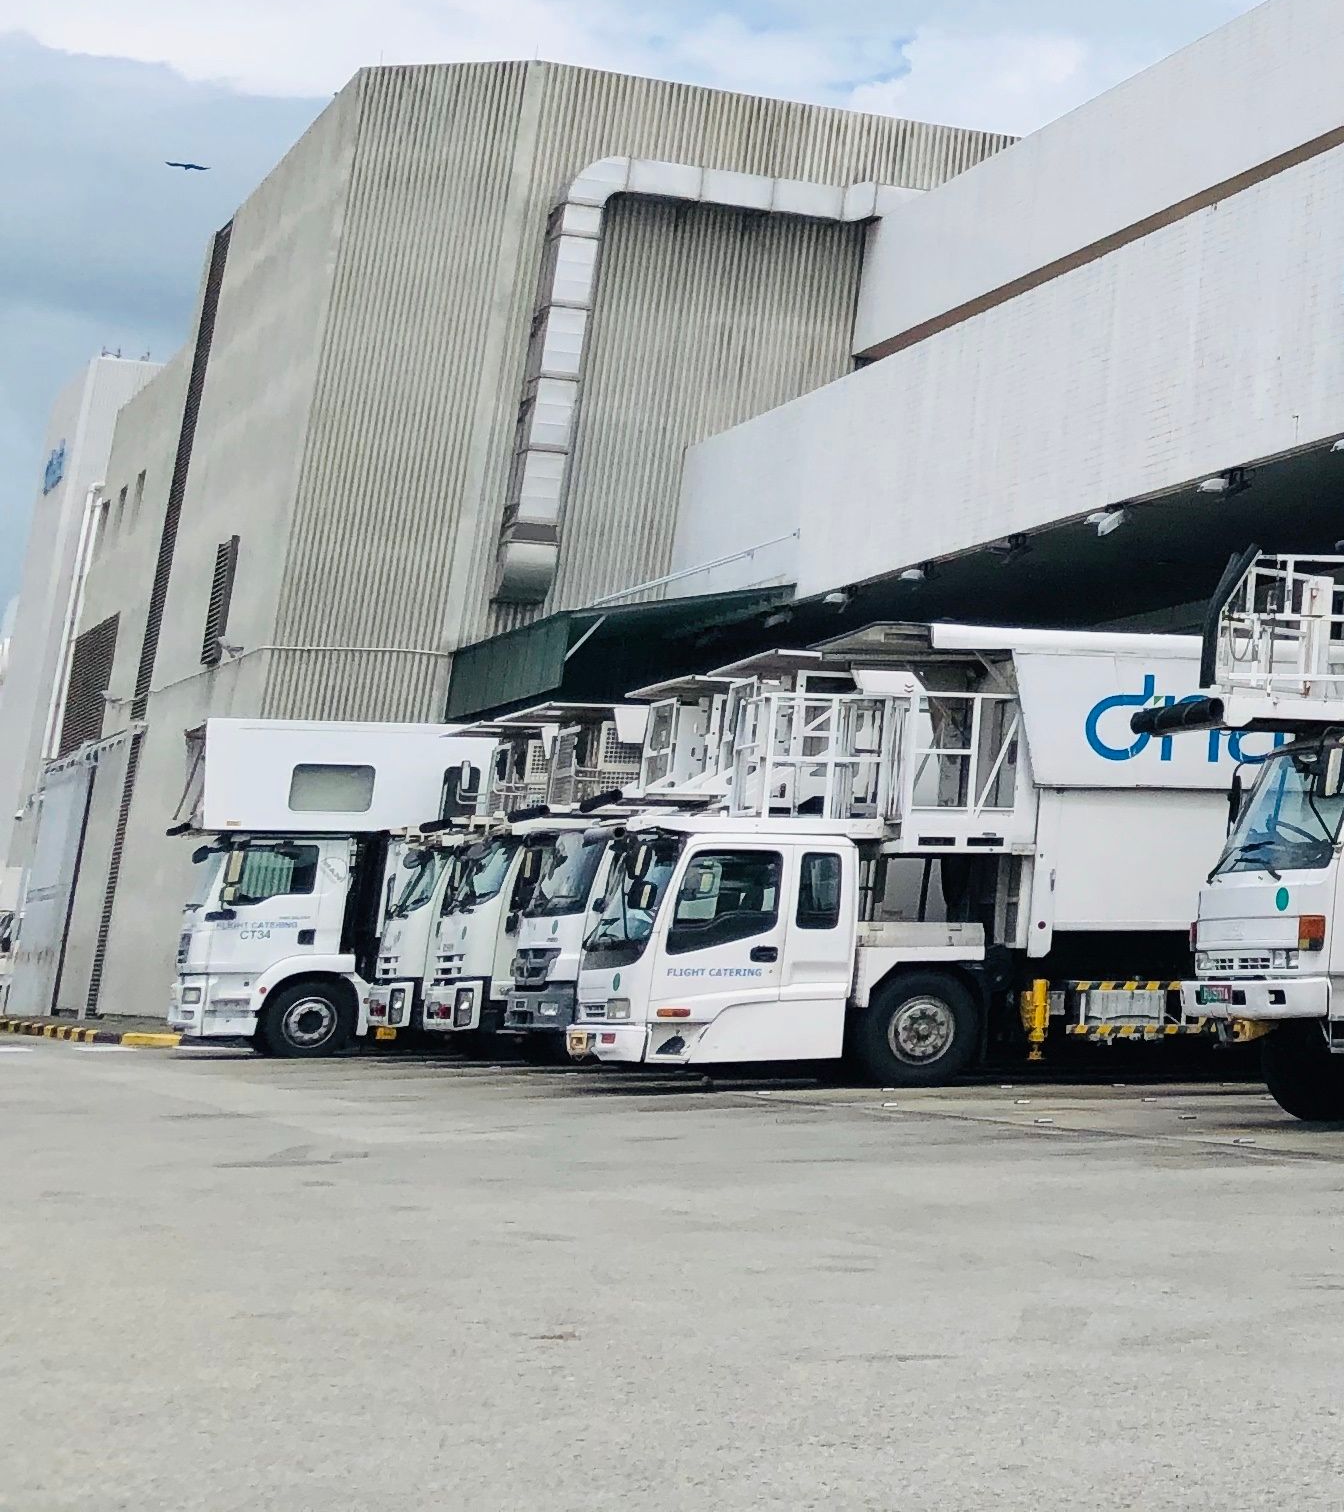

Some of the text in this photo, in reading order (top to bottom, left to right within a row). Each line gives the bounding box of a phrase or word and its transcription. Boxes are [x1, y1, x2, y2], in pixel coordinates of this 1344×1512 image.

[240, 929, 271, 940] CT34
[666, 968, 762, 977] FLIGHT CATERING
